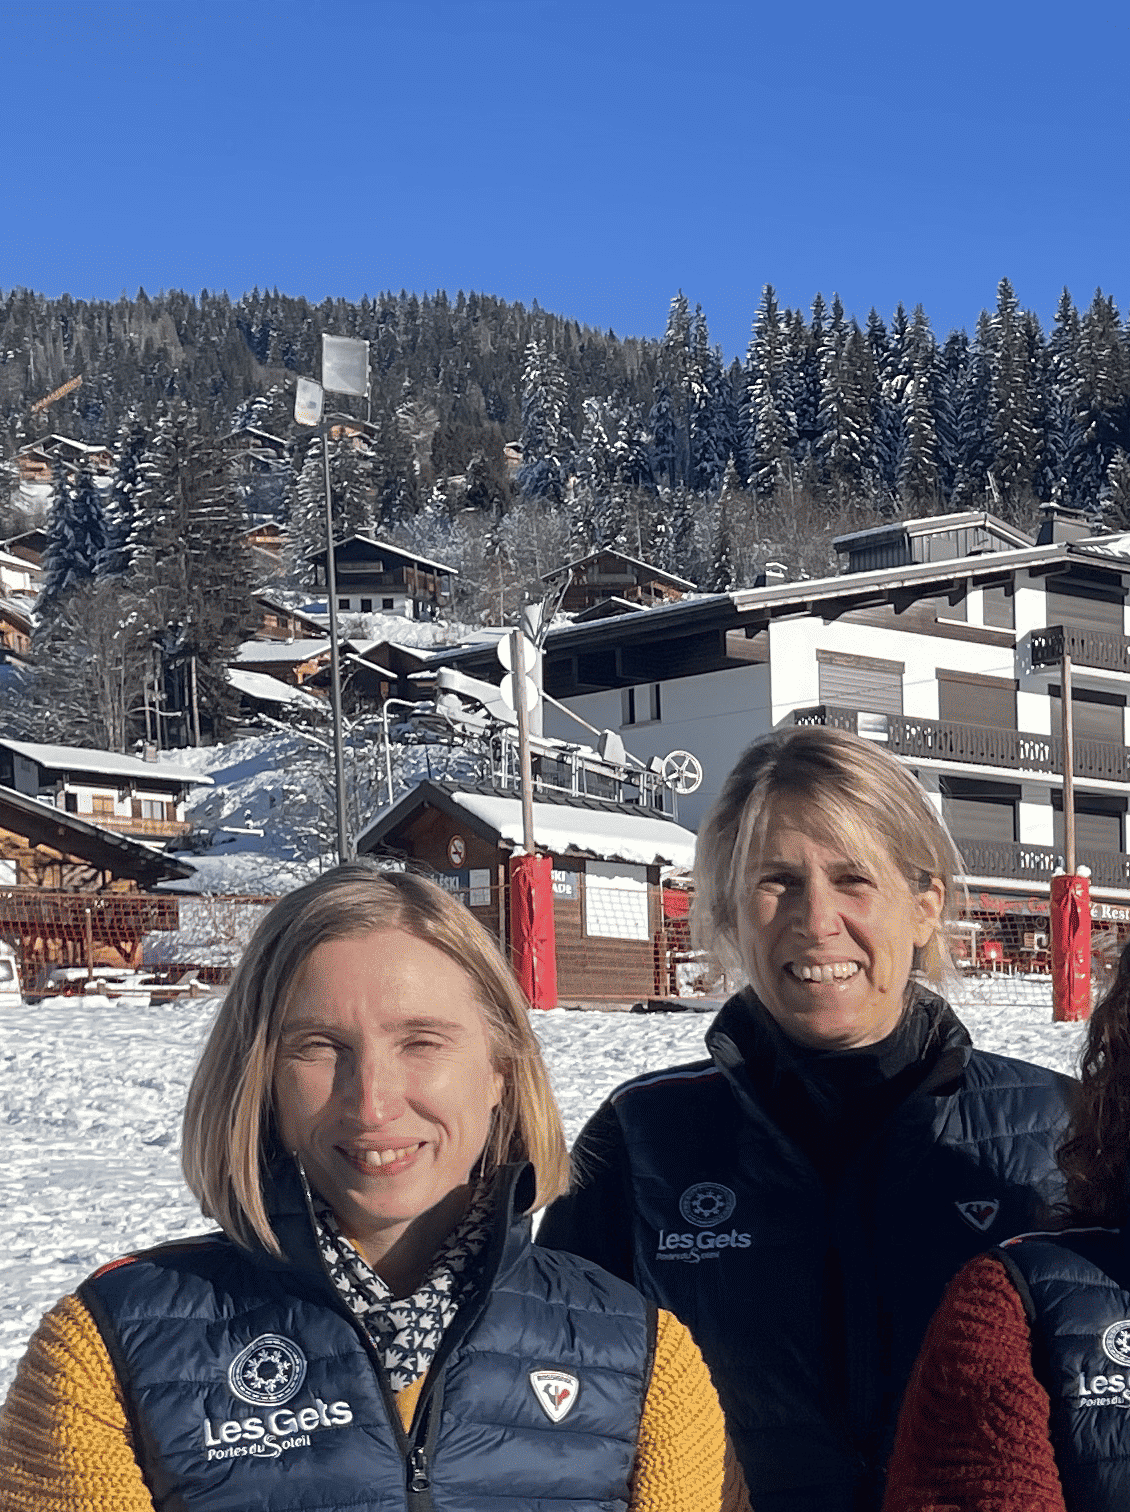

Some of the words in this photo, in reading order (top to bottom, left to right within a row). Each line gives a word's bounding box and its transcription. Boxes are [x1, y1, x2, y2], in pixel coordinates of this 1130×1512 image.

[658, 1229, 694, 1250] Les
[1078, 1371, 1126, 1395] Les
[205, 1417, 265, 1447] Les
[207, 1446, 248, 1461] Portes
[249, 1443, 266, 1455] du
[254, 1434, 312, 1458] Soleil
